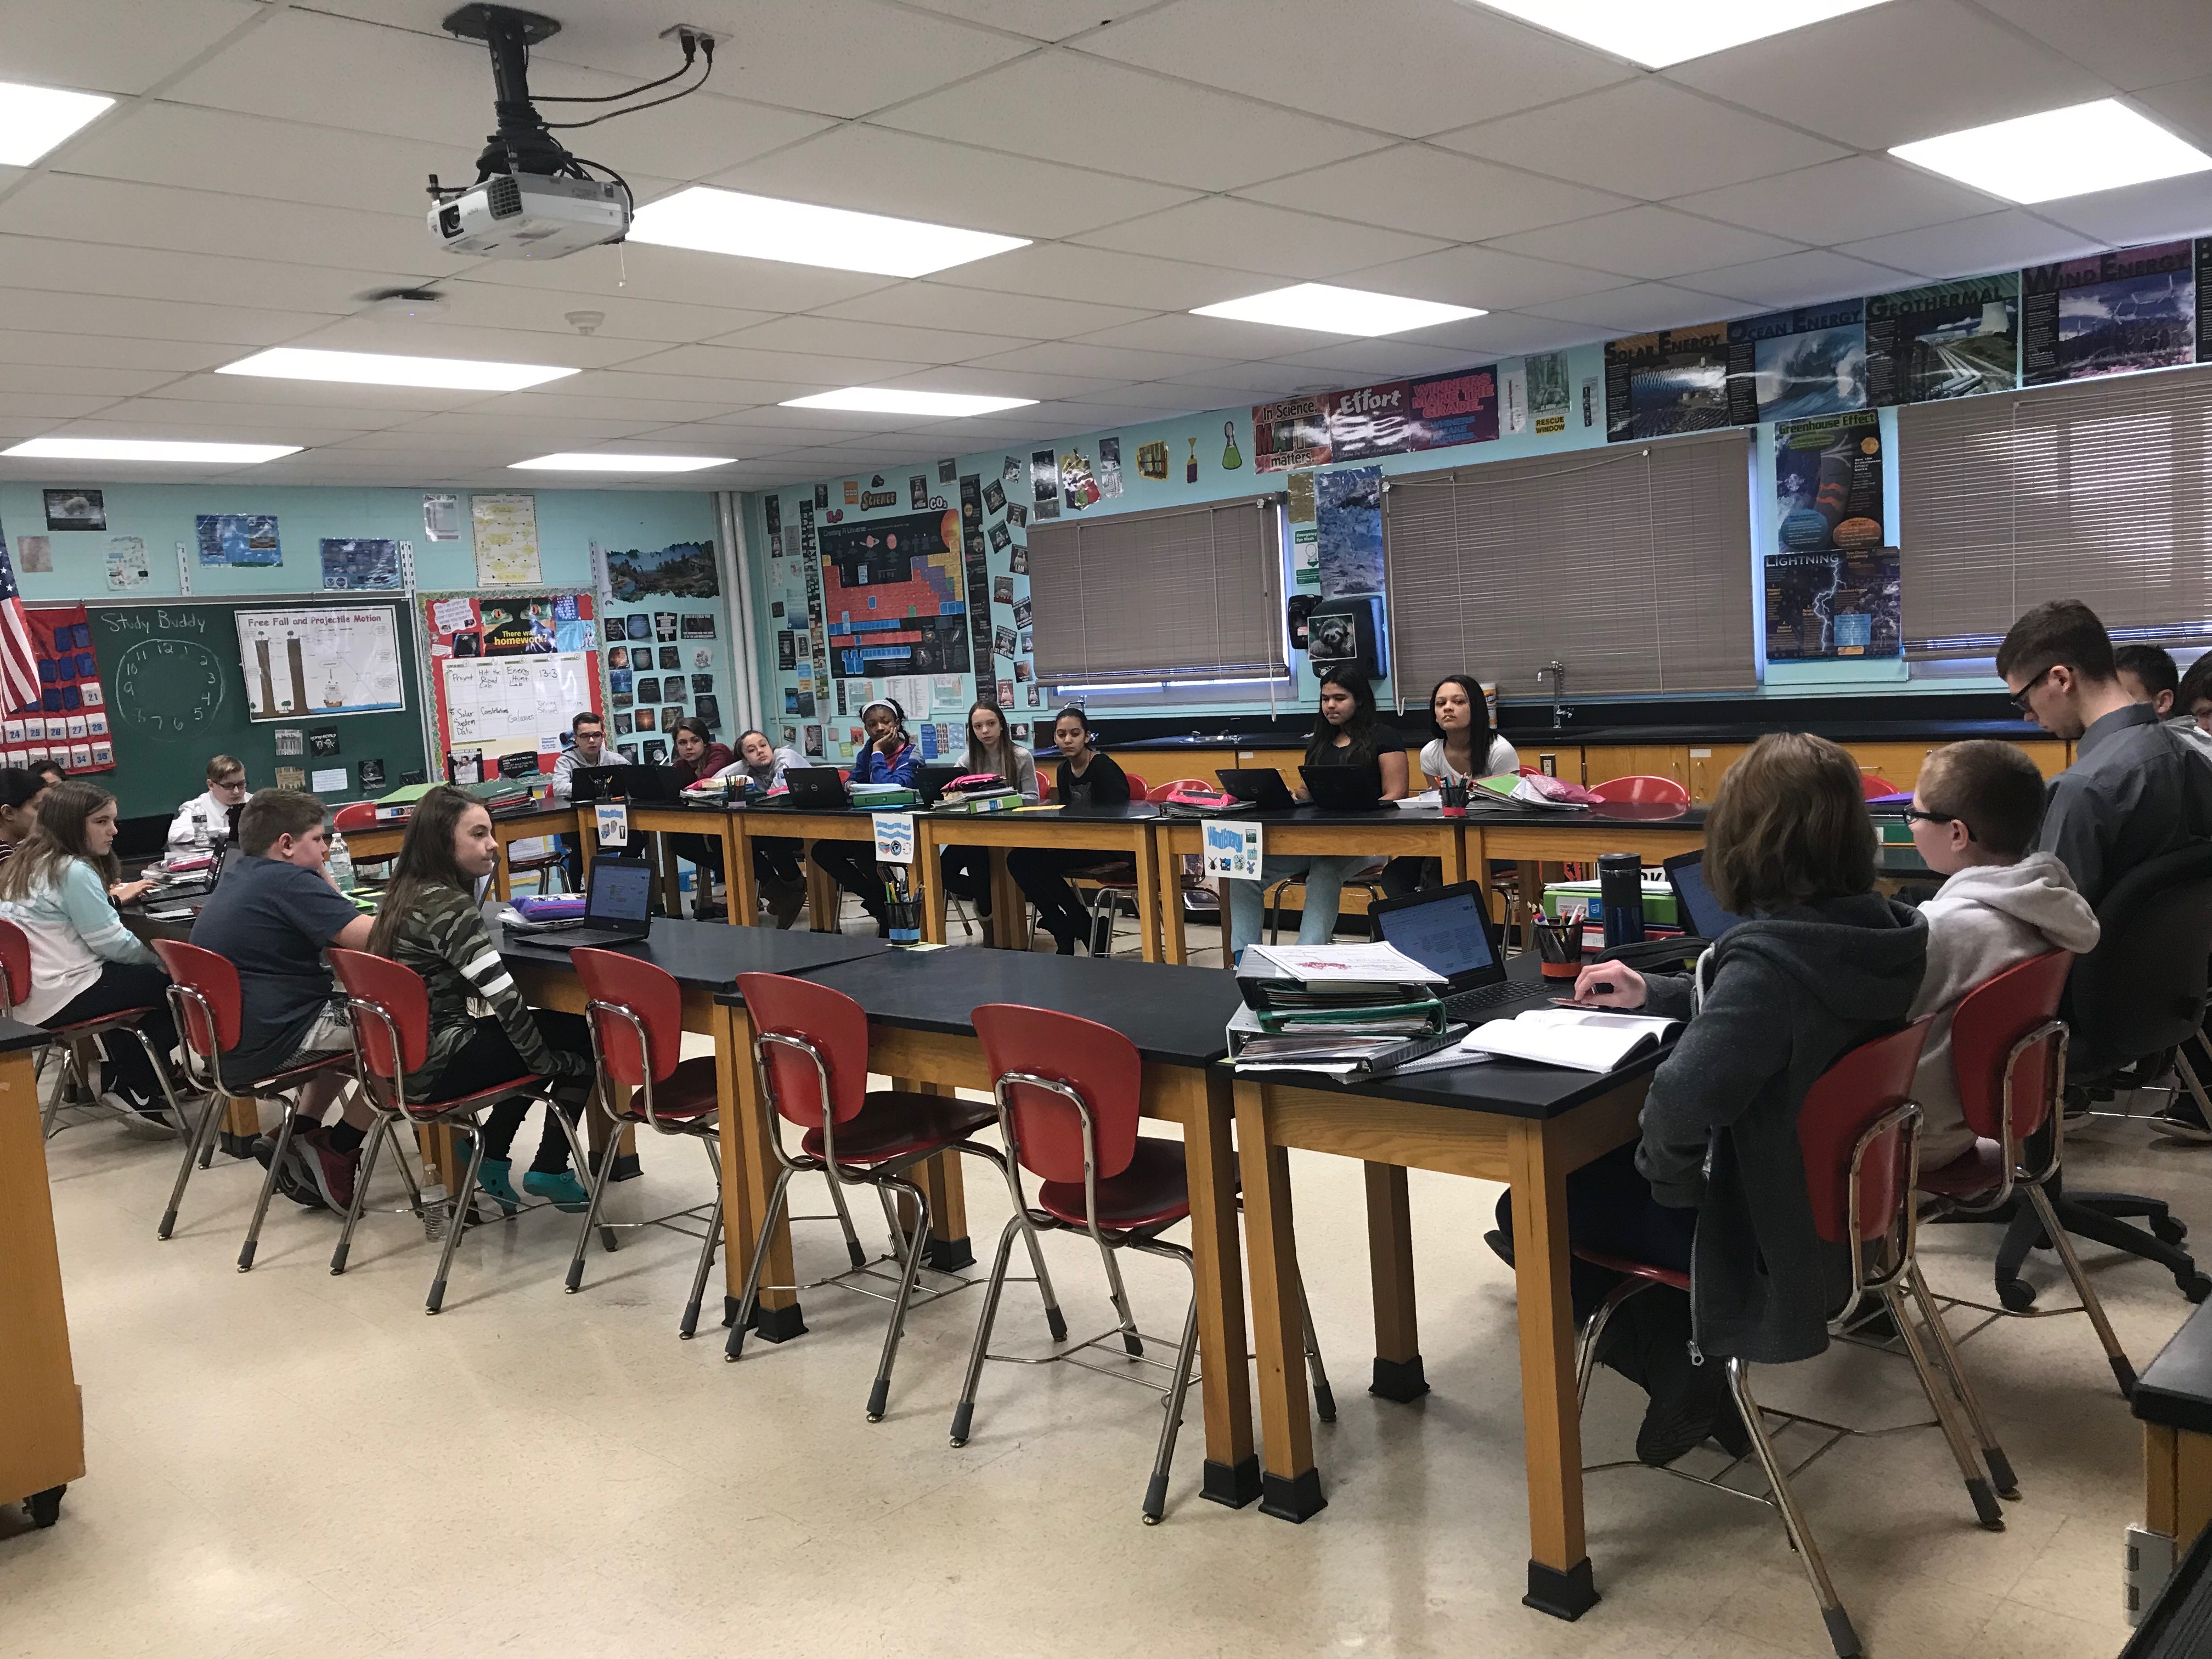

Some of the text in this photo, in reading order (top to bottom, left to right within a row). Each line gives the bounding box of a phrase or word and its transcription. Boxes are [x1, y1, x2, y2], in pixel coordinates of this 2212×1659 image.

[1866, 286, 2002, 318] GEOTHERMAL
[1728, 308, 1862, 341] OCEAN ENERGY
[1604, 331, 1720, 360] SOLAR ENERGY
[1413, 373, 1491, 397] WINNERS
[1340, 388, 1401, 414] Effort
[1412, 385, 1494, 409] MAKE THE
[1263, 402, 1317, 421] In Science,
[1423, 399, 1483, 418] GRADE.
[1536, 416, 1564, 426] RESCUE
[1779, 413, 1875, 435] Greenhouse Effect
[1536, 424, 1565, 433] WINDOW
[1271, 452, 1315, 467] matters.
[1766, 554, 1839, 567] LIGHTNING
[101, 610, 205, 634] Study Buddy
[248, 614, 381, 627] Free Fall and Projectile Motion
[494, 633, 548, 646] homework?
[157, 642, 173, 654] 12
[184, 646, 188, 654] 1
[137, 650, 146, 661] 11
[200, 656, 207, 665] 2
[127, 663, 138, 675] 10
[539, 668, 558, 678] 13-3
[207, 673, 216, 684] 3
[123, 681, 135, 698] 9
[88, 693, 99, 702] 21
[201, 692, 210, 706] 4
[194, 707, 203, 720] 5
[458, 709, 473, 718] Solar
[507, 709, 535, 724] Galaxies
[92, 723, 103, 731] 28
[150, 715, 162, 730] 7
[173, 717, 184, 731] 6
[10, 730, 20, 739] 24
[30, 729, 40, 737] 25
[72, 726, 82, 735] 27
[77, 755, 86, 764] 34
[97, 752, 108, 760] 35
